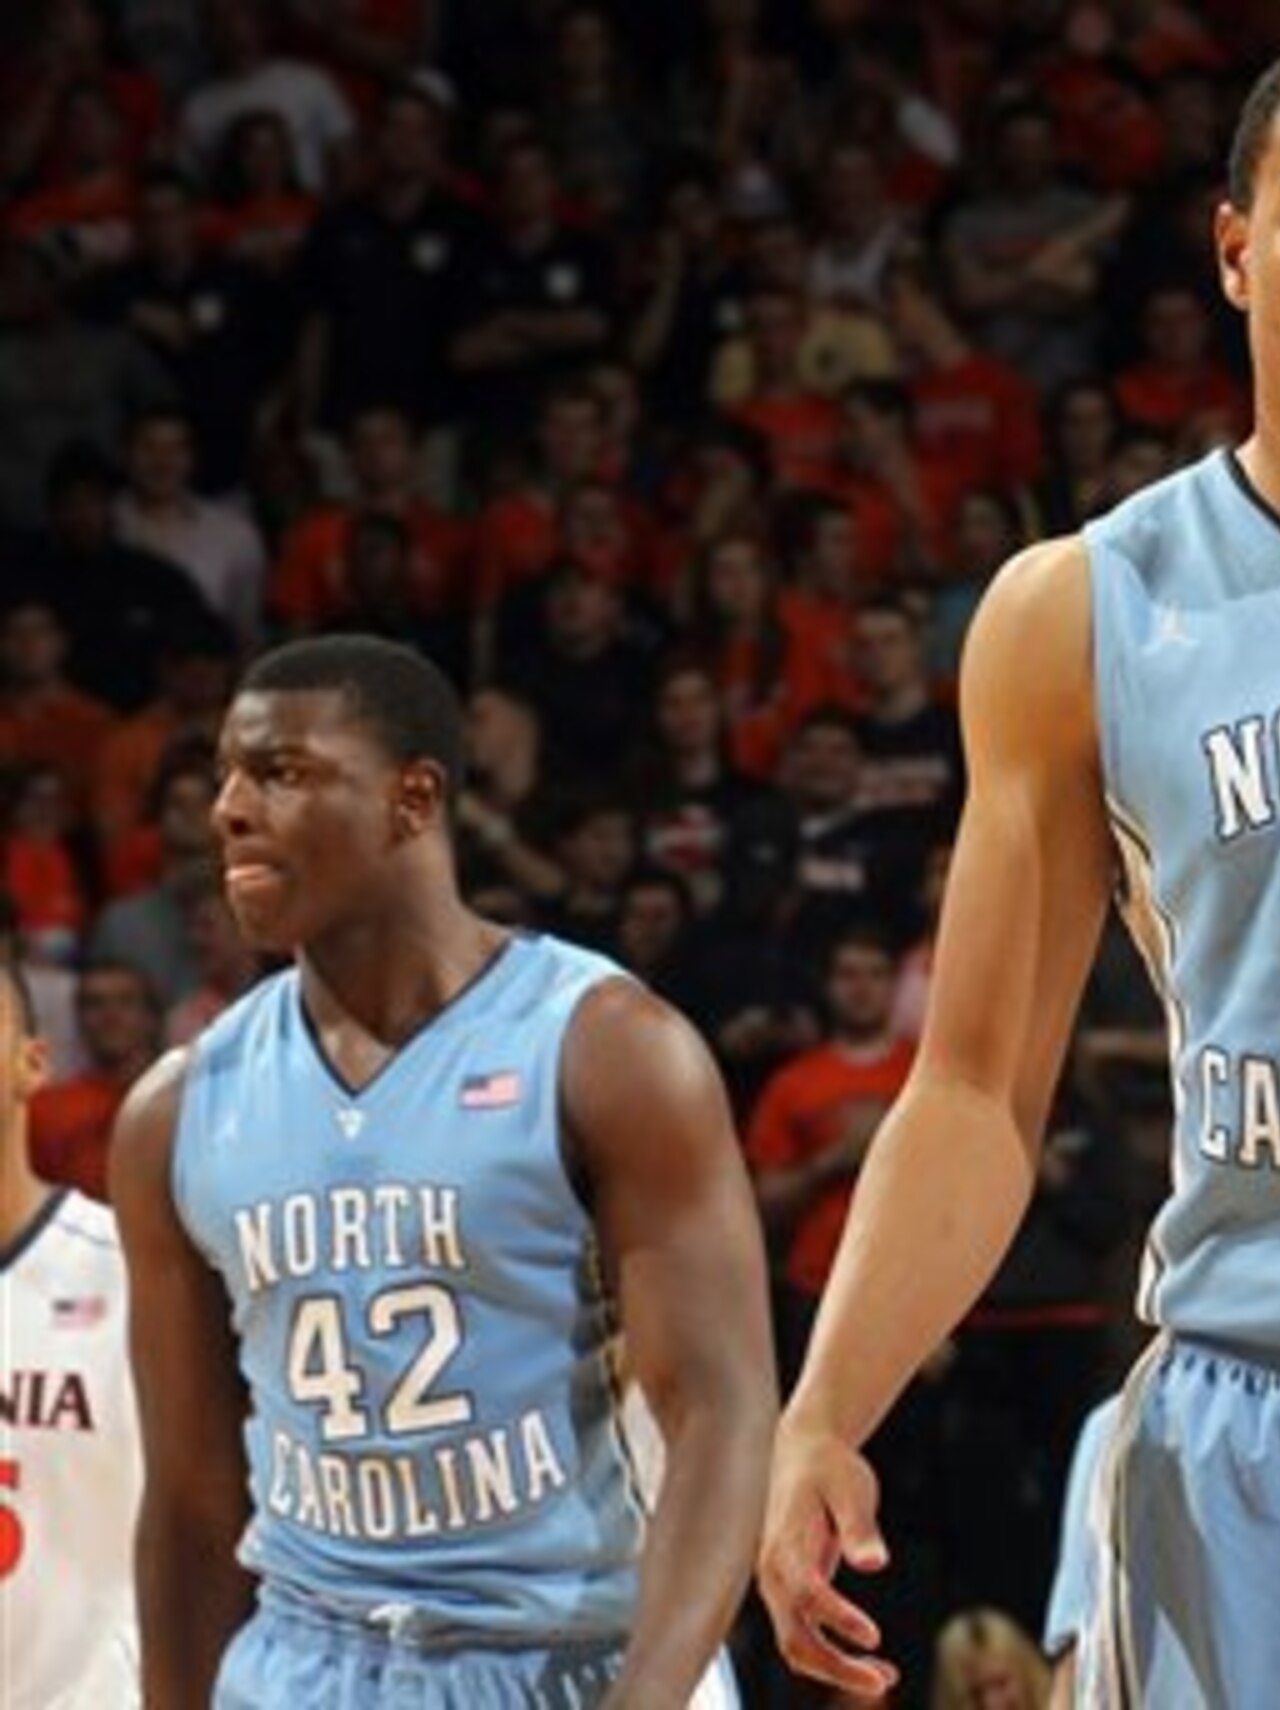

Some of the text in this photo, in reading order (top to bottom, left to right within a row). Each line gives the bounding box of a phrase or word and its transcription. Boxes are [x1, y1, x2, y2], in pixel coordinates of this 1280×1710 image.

[233, 1183, 467, 1293] NORTH
[285, 1281, 474, 1441] 42
[266, 1408, 568, 1541] CAROLINA
